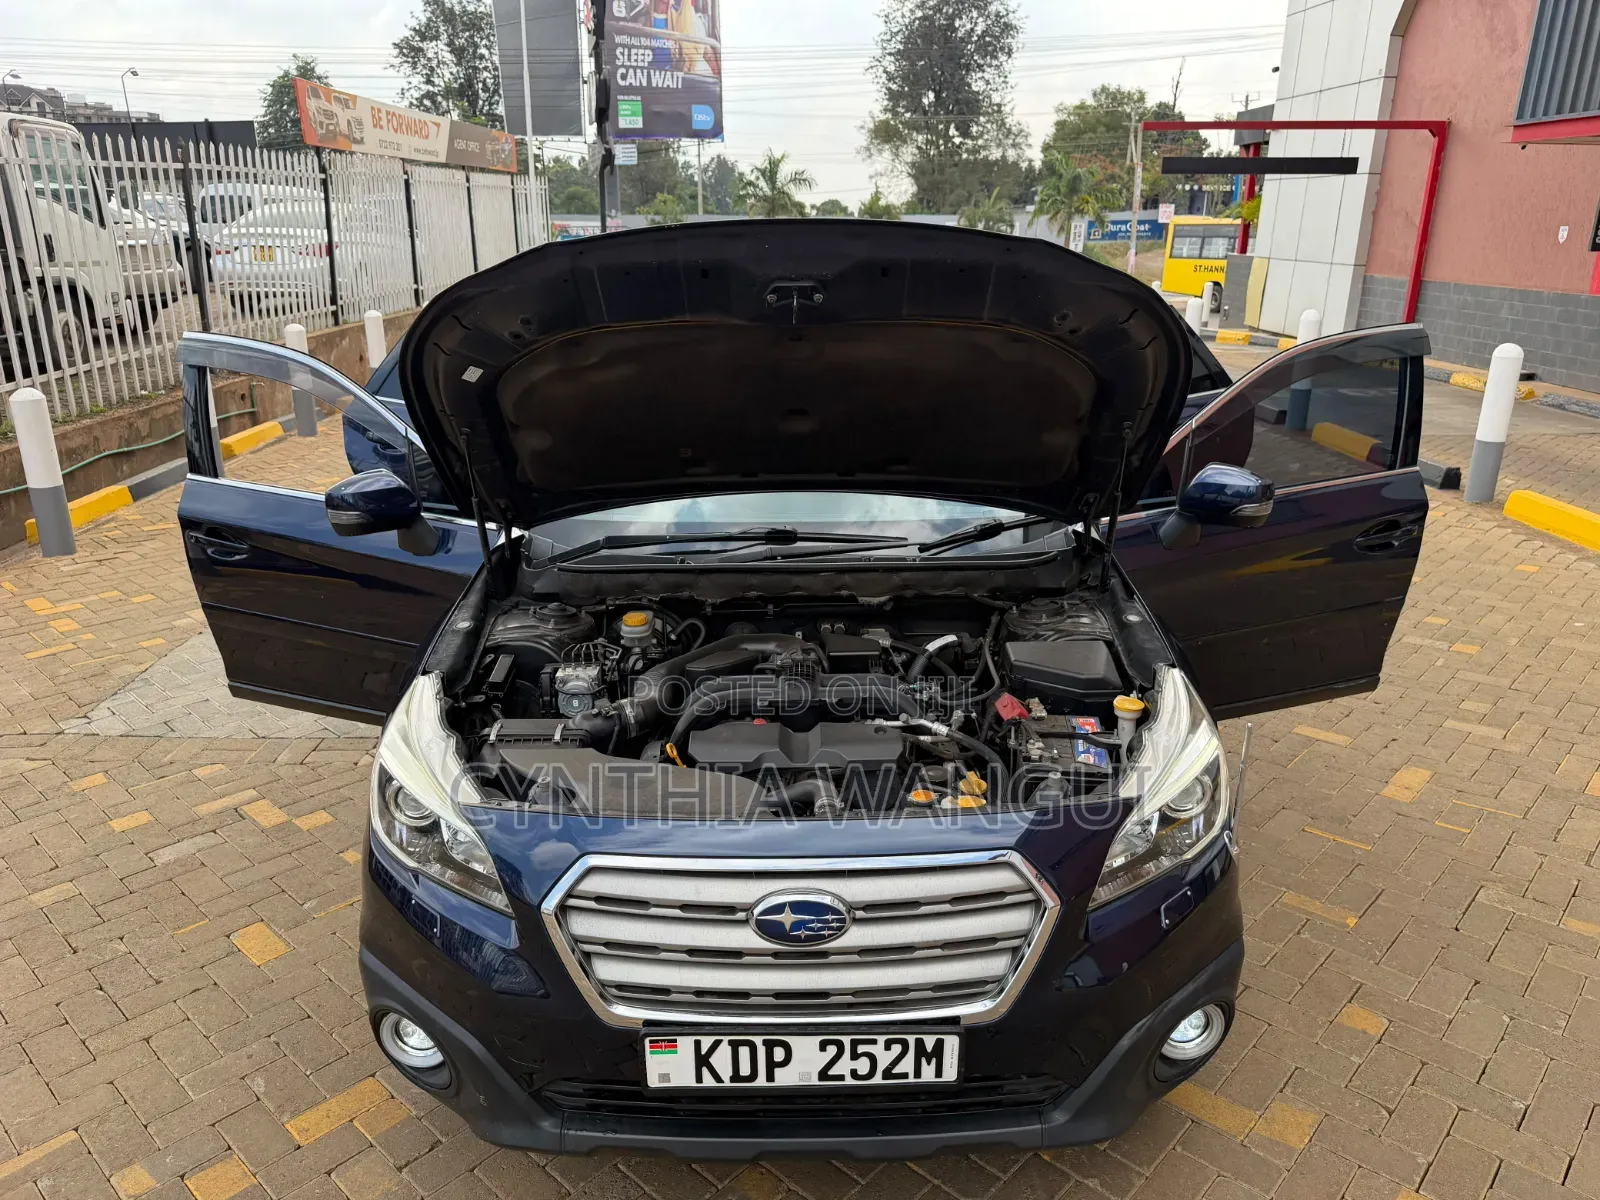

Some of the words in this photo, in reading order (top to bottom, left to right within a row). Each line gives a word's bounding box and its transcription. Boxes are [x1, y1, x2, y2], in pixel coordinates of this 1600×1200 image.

[613, 33, 631, 45] WITH
[630, 36, 641, 46] ALL
[615, 46, 653, 67] SLEEP
[616, 67, 648, 87] CAN
[649, 69, 685, 89] WAIT
[371, 106, 383, 130] BE
[385, 110, 429, 139] FORWARD
[693, 1038, 793, 1084] KDP
[818, 1037, 945, 1081] 252M
